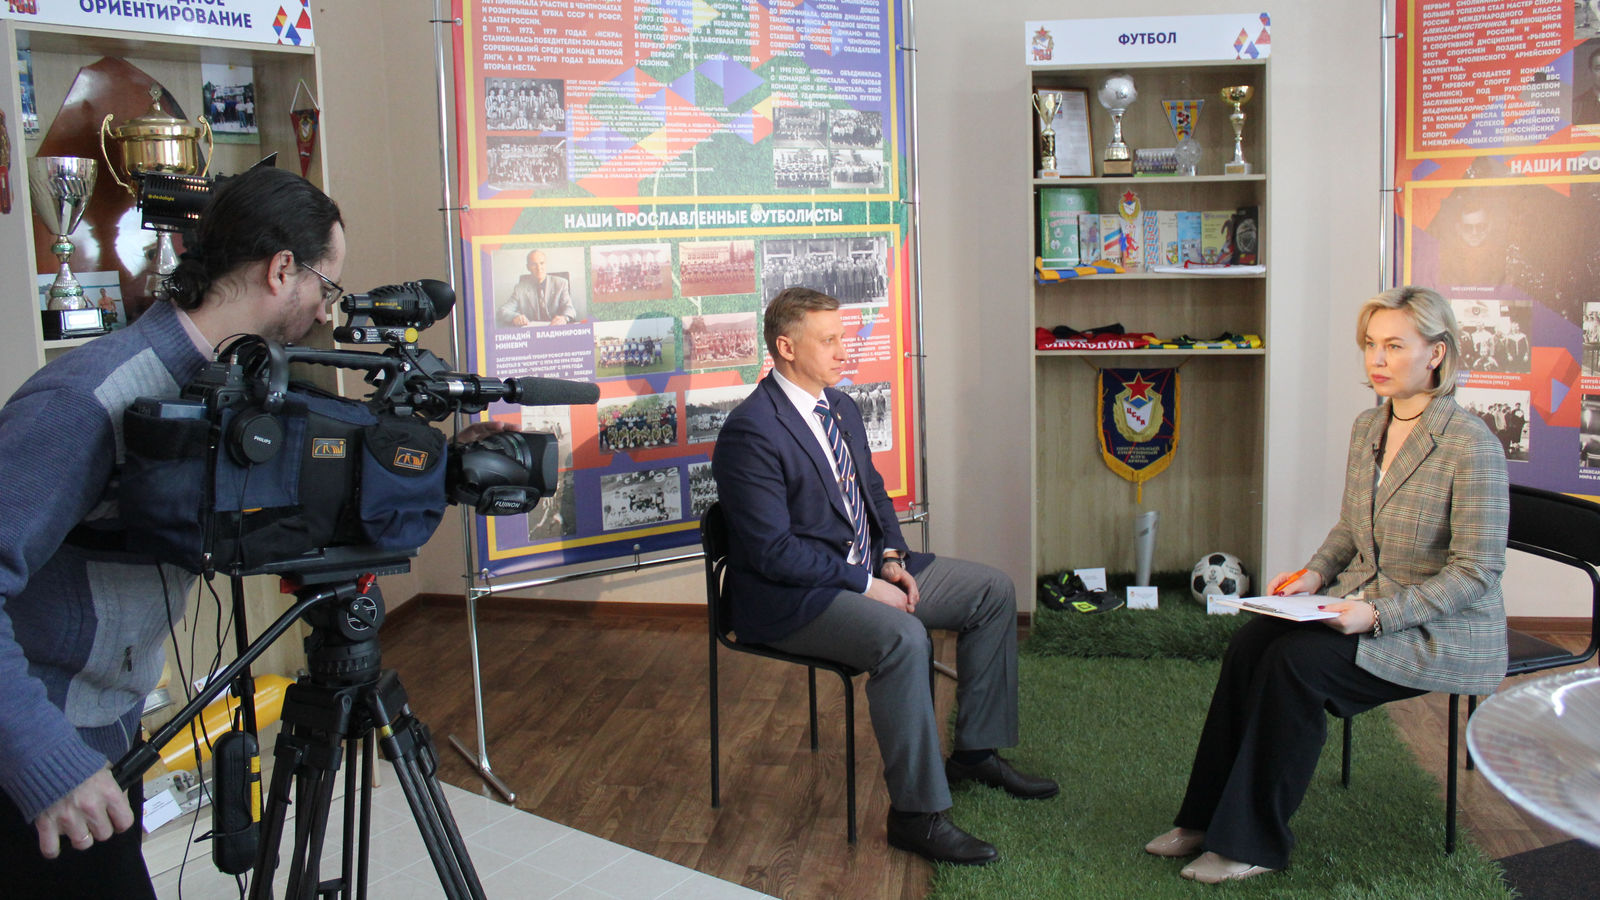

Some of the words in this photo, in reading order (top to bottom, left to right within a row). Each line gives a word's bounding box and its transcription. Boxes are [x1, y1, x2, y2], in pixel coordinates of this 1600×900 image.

[489, 7, 538, 15] РОЗЫГРЫШАХ
[576, 3, 622, 11] ЧЕМПИОНАТАХ
[1423, 2, 1450, 11] ПЕРВЫМ
[1423, 10, 1454, 19] БОЛЬШИХ
[1456, 6, 1486, 15] УСПЕХОВ
[1506, 1, 1533, 9] МАСТЕР
[79, 0, 253, 28] ОРИЕНТИРОВАНИЕ
[1423, 19, 1449, 27] РОССИИ
[1458, 10, 1523, 23] МЕЖДУНАРОДНОГО
[1533, 6, 1562, 14] КЛАССА
[1510, 14, 1562, 25] ЯВЛЯЮЩИЙСЯ
[565, 29, 587, 37] ГОДАХ
[634, 24, 668, 32] БОРОЛАСЬ
[1423, 32, 1474, 43] РЕКОРДСМЕНОМ
[1487, 28, 1515, 36] РОССИИ
[1542, 23, 1562, 31] МИРА
[483, 35, 533, 43] СТАНОВИЛАСЬ
[534, 37, 581, 45] ПОБЕДИТЕЛЕМ
[582, 39, 623, 47] ЗОНАЛЬНЫХ
[700, 36, 735, 44] ЗАВОЕВАЛА
[1118, 32, 1177, 45] ФУТБОЛ
[1430, 39, 1474, 50] СПОРТИВНОЙ
[1477, 35, 1523, 46] ДИСЦИПЛИНЕ
[483, 44, 538, 52] СОРЕВНОВАНИЙ
[1447, 47, 1486, 56] СПОРТСМЕН
[1496, 43, 1526, 52] ПОЗДНЕЕ
[1536, 40, 1561, 48] СТАНЕТ
[1457, 54, 1506, 63] СМОЛЕНСКОГО
[1515, 48, 1561, 58] АРМЕЙСКОГО
[1422, 66, 1466, 75] КОЛЛЕКТИВА.
[1450, 73, 1466, 81] ГОДУ
[1472, 70, 1511, 79] СОЗДАЕТСЯ
[1520, 66, 1555, 74] КОМАНДА
[1442, 80, 1475, 89] ГИРЕВОМУ
[1484, 78, 1510, 86] СПОРТУ
[1423, 90, 1463, 99] (СМОЛЕНСК)
[1504, 82, 1560, 92] РУКОВОДСТВОМ
[1423, 97, 1474, 106] ЗАСЛУЖЕННОГО
[1488, 94, 1515, 102] ТРЕНЕРА
[1423, 107, 1462, 115] ВЛАДИМИРА
[1501, 109, 1536, 118] БОЛЬШОЙ
[1536, 107, 1560, 115] ВКЛАД
[1436, 122, 1466, 130] КОПИЛКУ
[1513, 116, 1560, 126] АРМЕЙСКОГО
[1495, 124, 1555, 134] ВСЕРОССИЙСКИХ
[1510, 159, 1562, 174] НАШИ
[564, 212, 612, 229] НАШИ
[616, 210, 748, 227] ПРОСЛАВЛЕННЫЕ
[750, 208, 843, 225] ФУТБОЛИСТЫ
[495, 331, 530, 342] ГЕННАДИЙ
[536, 328, 591, 338] ВЛАДИМИРОВИЧ
[496, 341, 527, 350] МИНЕВИЧ
[1126, 407, 1146, 426] ЦСКА
[253, 435, 271, 445] PHILIPS
[494, 500, 521, 508] FUJINON
